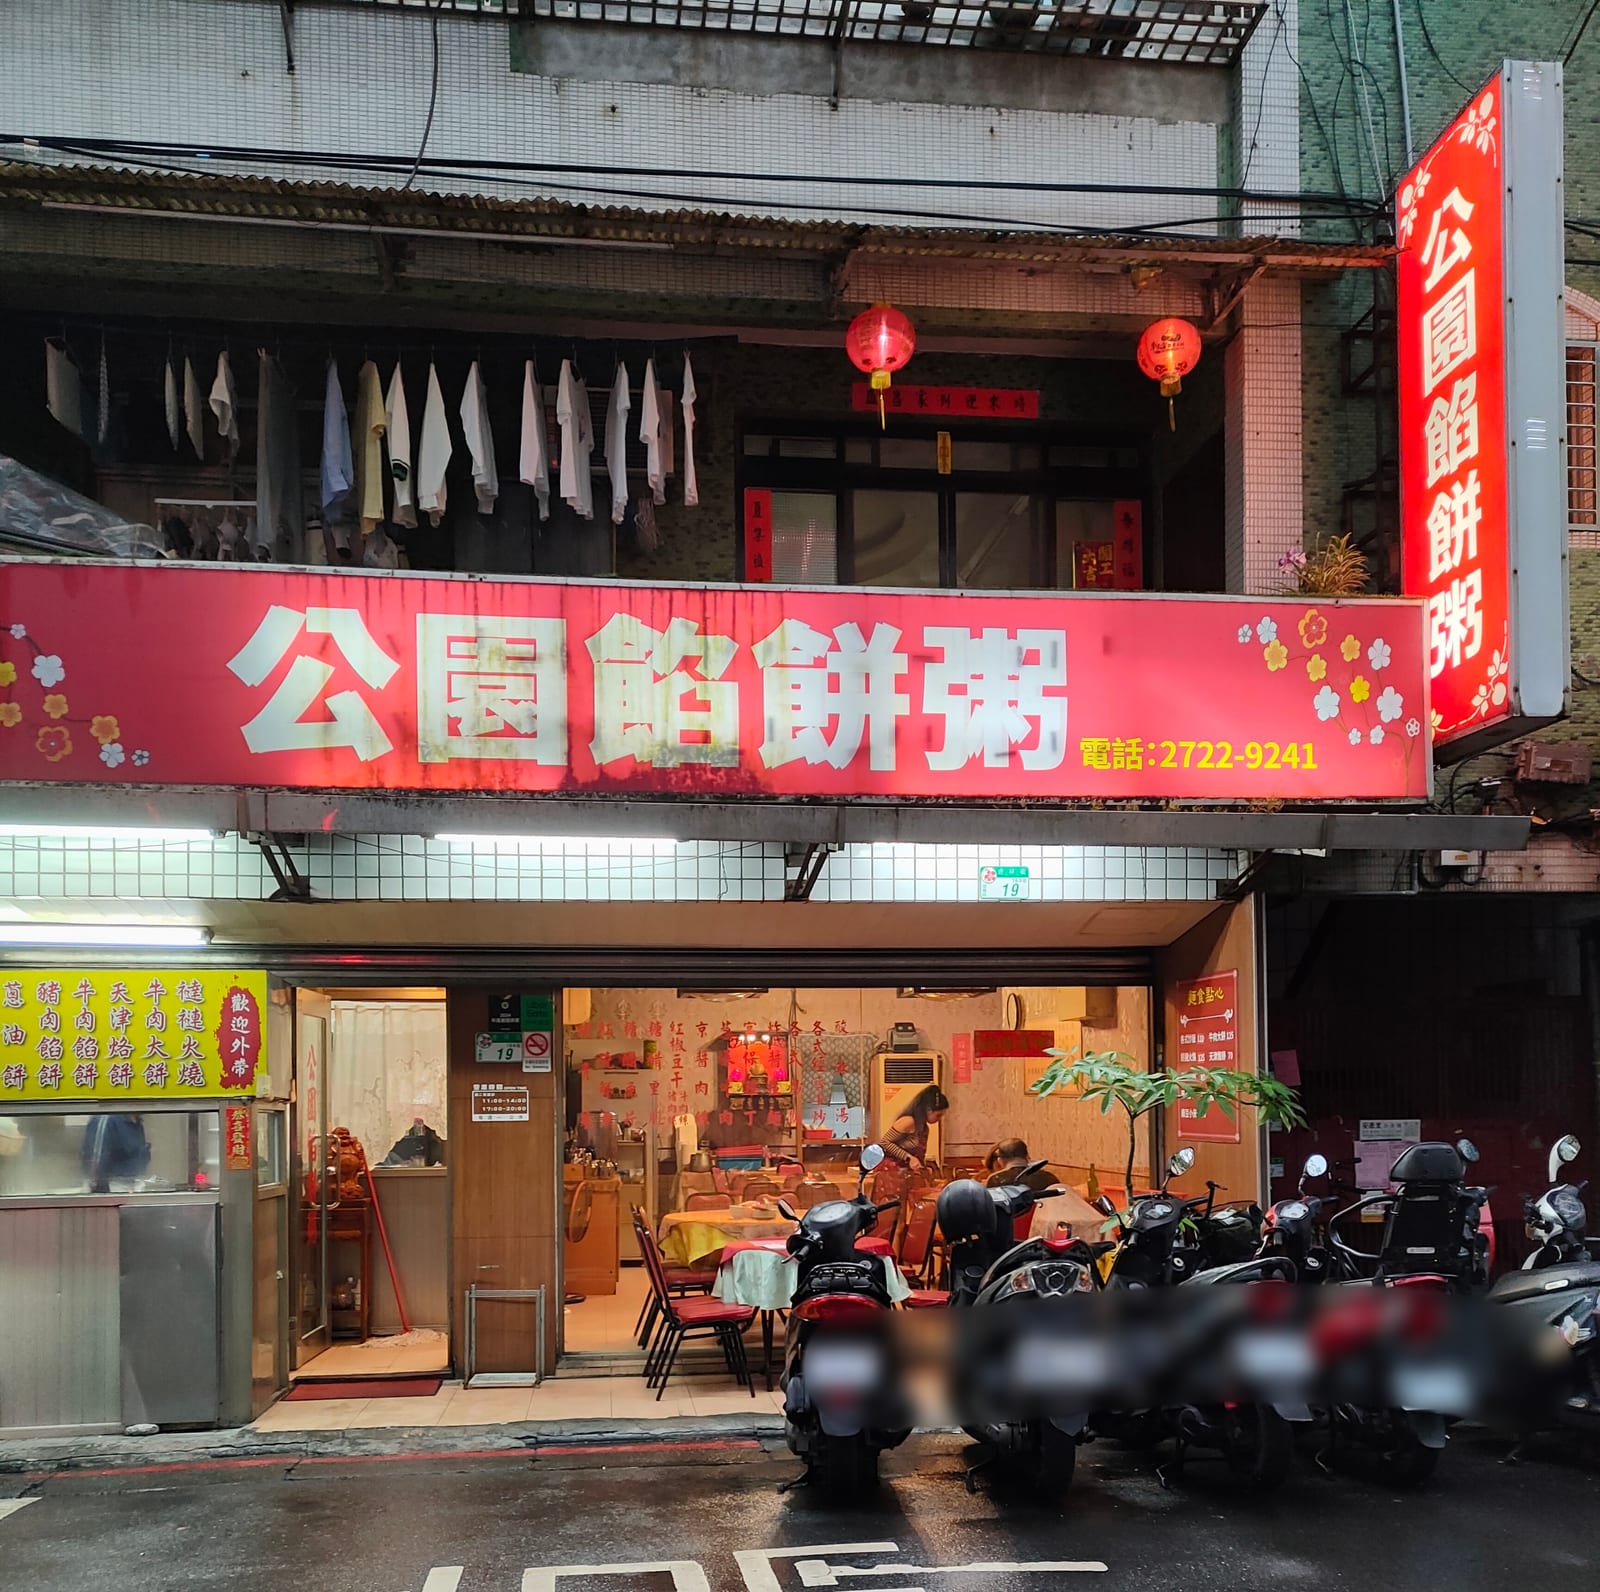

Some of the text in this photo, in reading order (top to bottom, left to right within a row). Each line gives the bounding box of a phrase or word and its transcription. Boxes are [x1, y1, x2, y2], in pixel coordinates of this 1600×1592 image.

[1421, 186, 1482, 680] 公園餡餅粥
[226, 604, 1068, 772] 公園餡餅粥
[1002, 883, 1019, 897] 19
[36, 979, 63, 1090] 豬肉餡餅
[72, 977, 99, 1089] 牛肉餡餅
[107, 980, 134, 1090] 天津烙餅
[141, 977, 170, 1089] 牛肉大餅
[230, 993, 250, 1078] 歡迎外帶
[497, 1048, 513, 1060] 19
